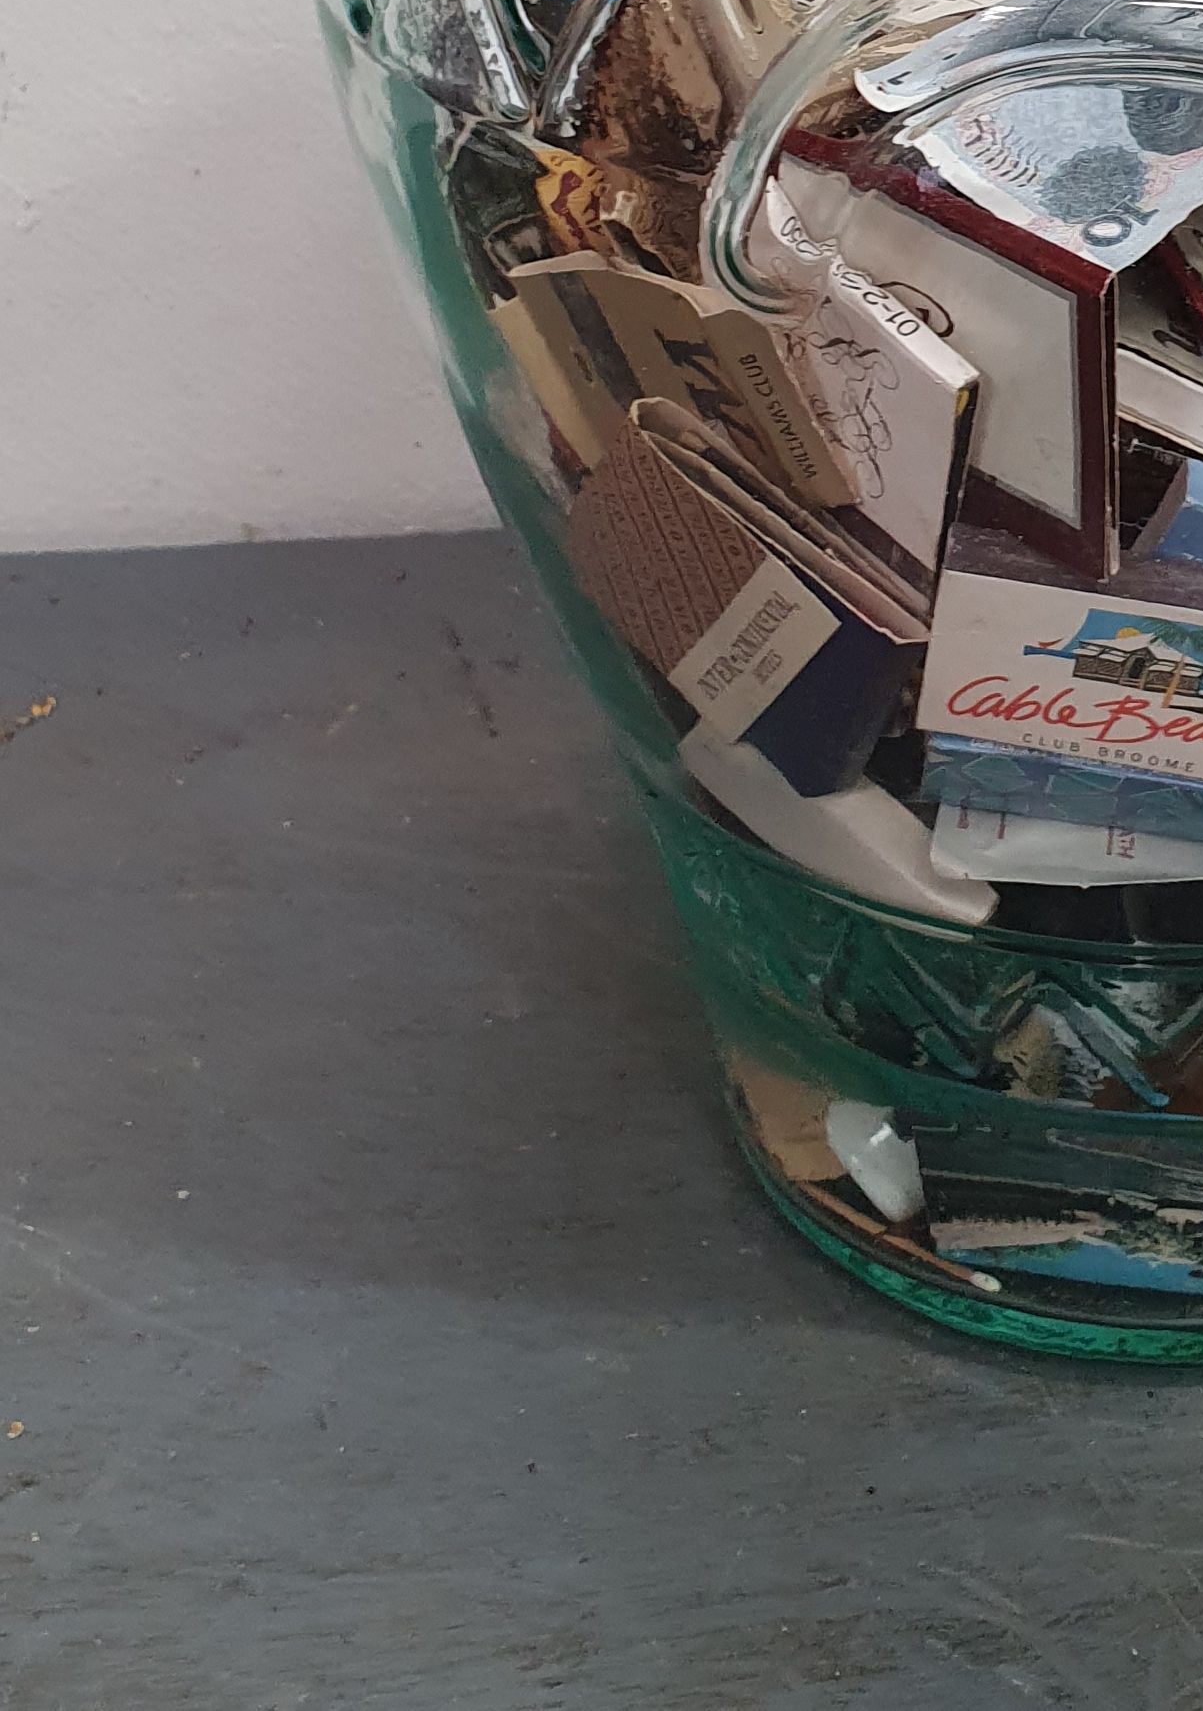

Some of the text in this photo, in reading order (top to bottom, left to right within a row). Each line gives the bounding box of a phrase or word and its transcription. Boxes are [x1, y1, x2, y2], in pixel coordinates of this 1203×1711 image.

[738, 353, 819, 480] WILLIAMS CLUB
[945, 675, 1098, 730] Cable
[1020, 731, 1082, 754] CLUB
[1098, 746, 1199, 775] BROOME
